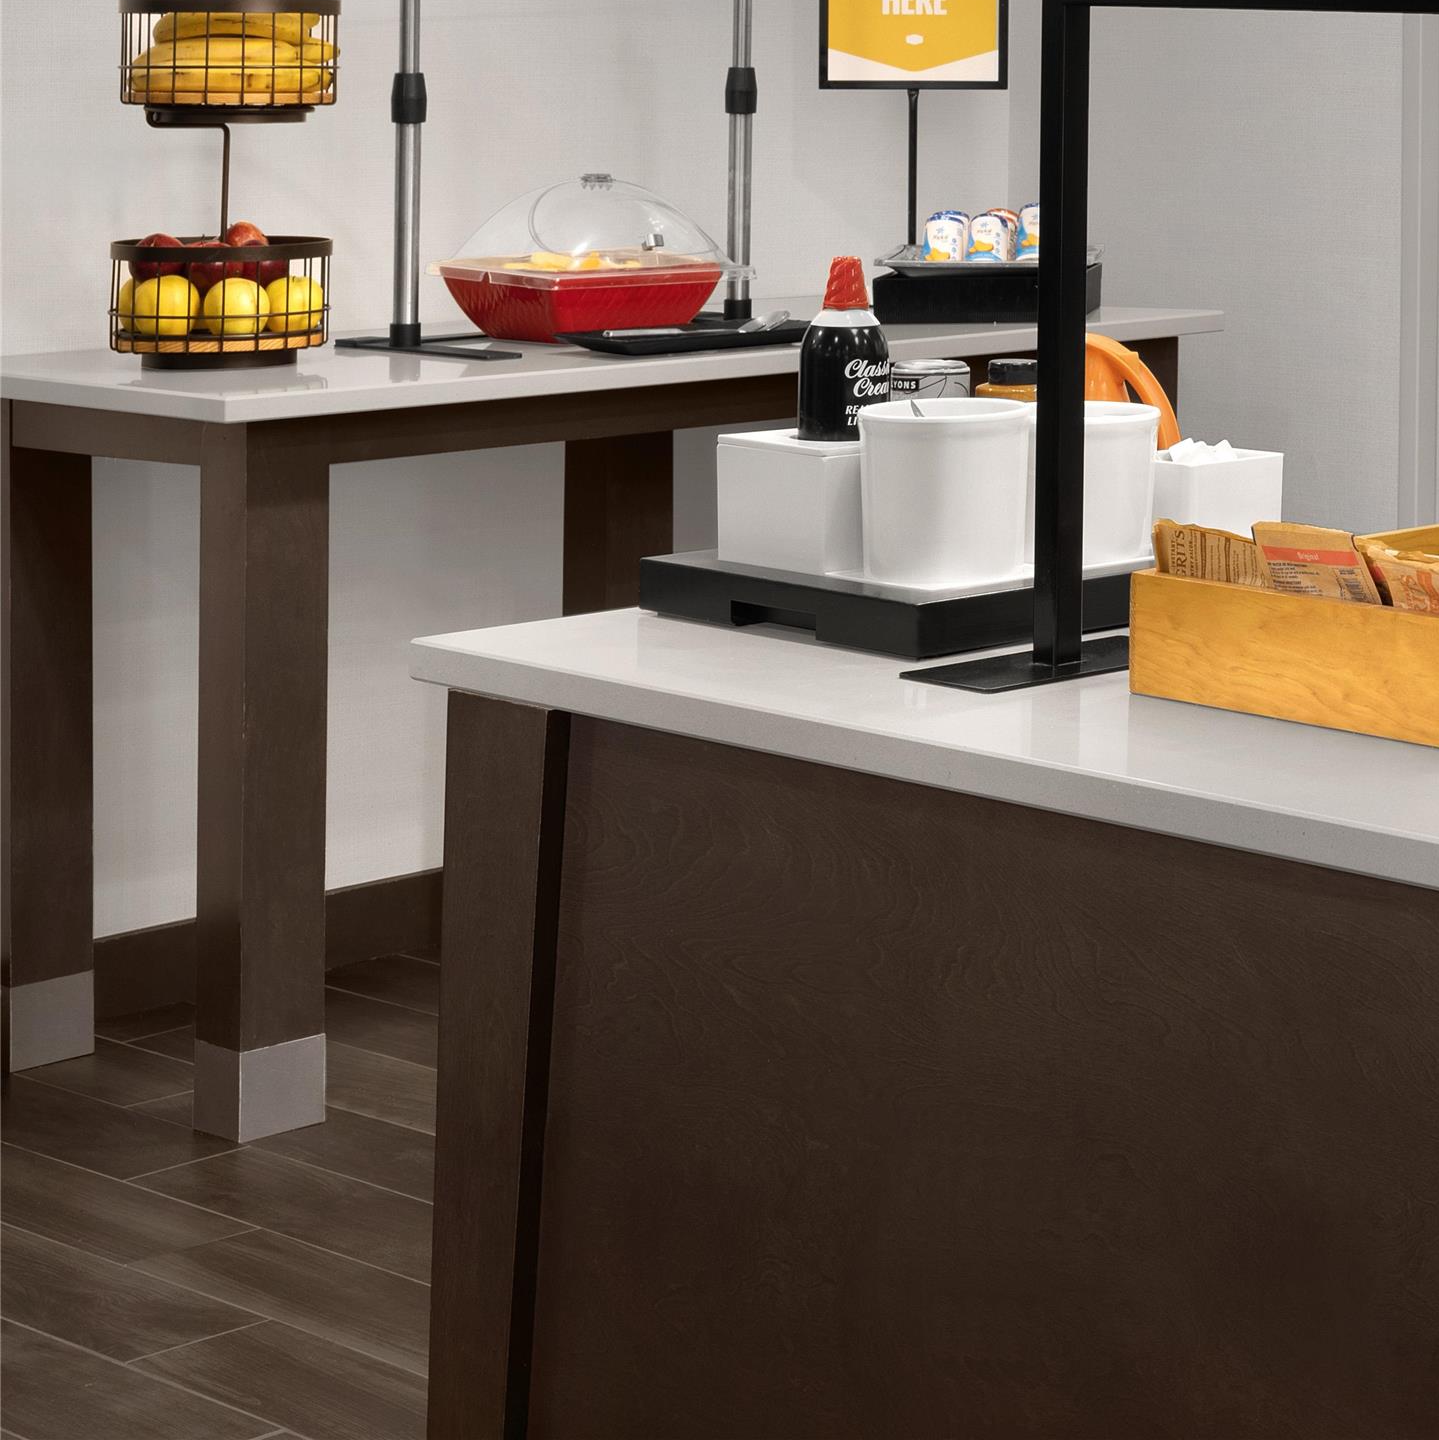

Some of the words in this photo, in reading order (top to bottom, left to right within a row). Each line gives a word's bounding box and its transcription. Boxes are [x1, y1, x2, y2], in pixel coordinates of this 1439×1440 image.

[844, 358, 890, 379] Classi
[853, 377, 889, 398] Crea
[1174, 529, 1187, 576] GRITS
